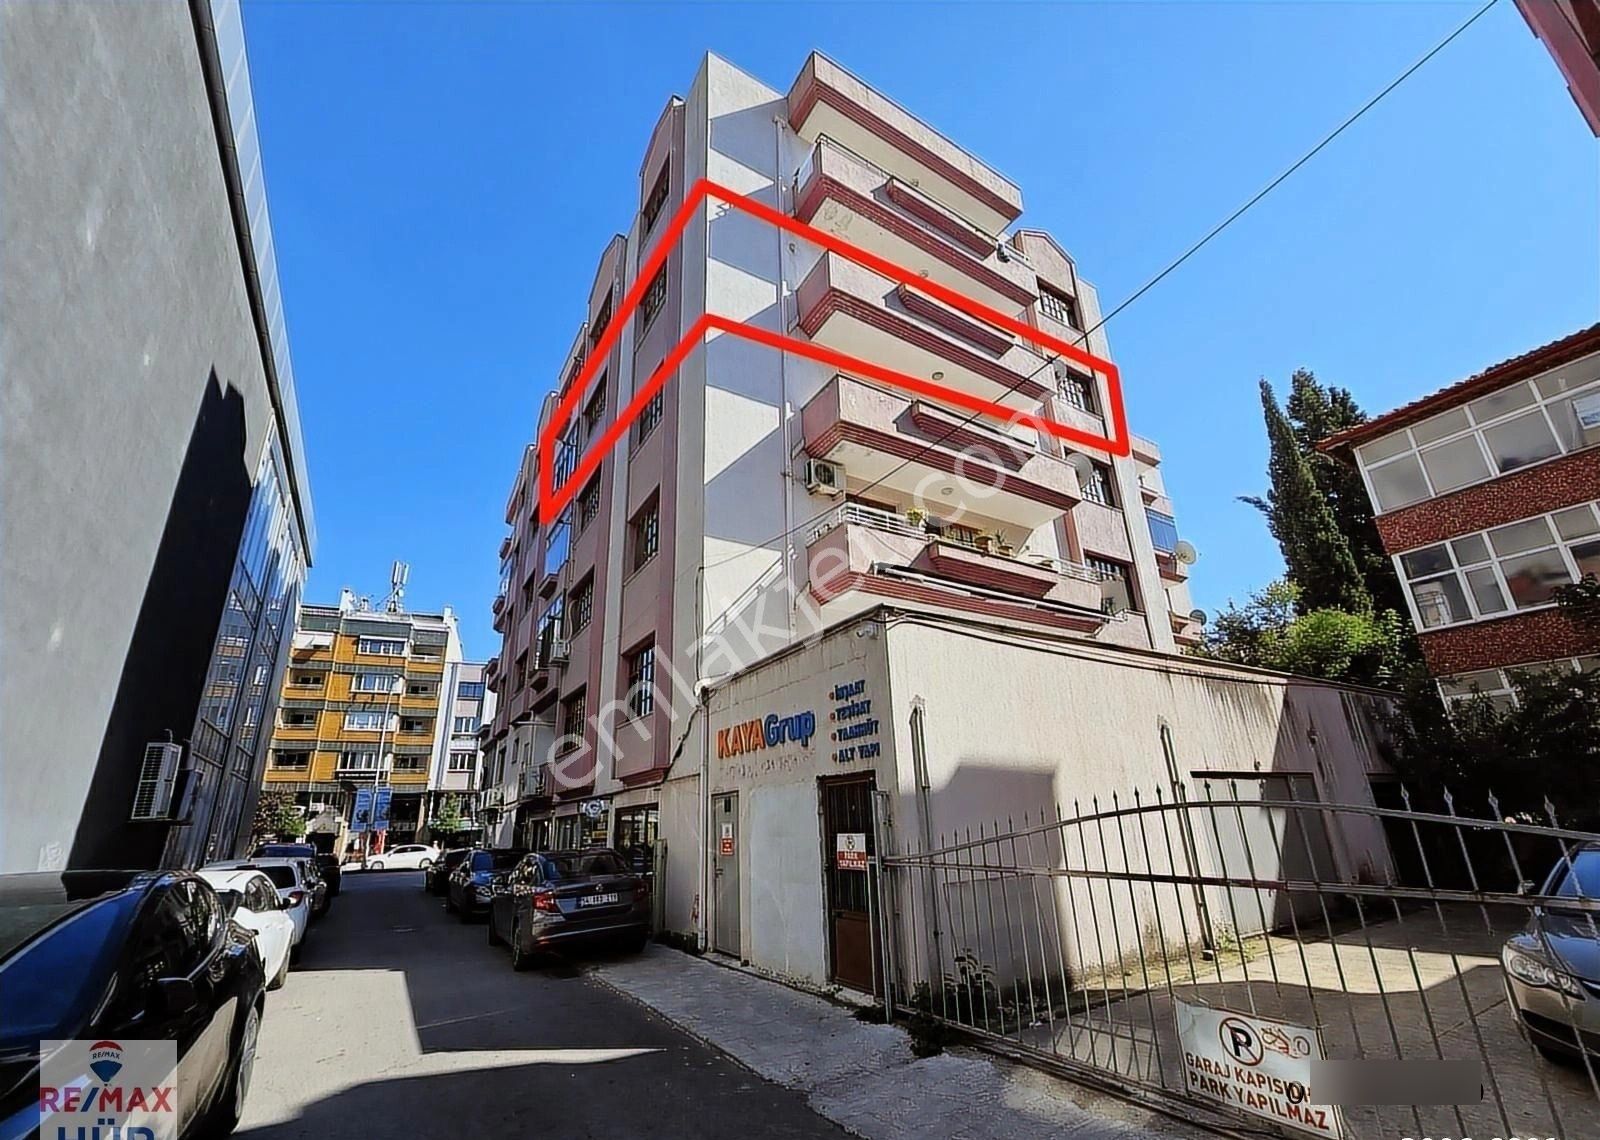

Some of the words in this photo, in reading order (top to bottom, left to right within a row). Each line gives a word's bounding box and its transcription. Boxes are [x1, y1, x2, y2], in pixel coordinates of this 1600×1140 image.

[1185, 1052, 1230, 1079] GARAJ
[1189, 1070, 1233, 1099] PARK
[1234, 1085, 1330, 1131] YAPILMAZ
